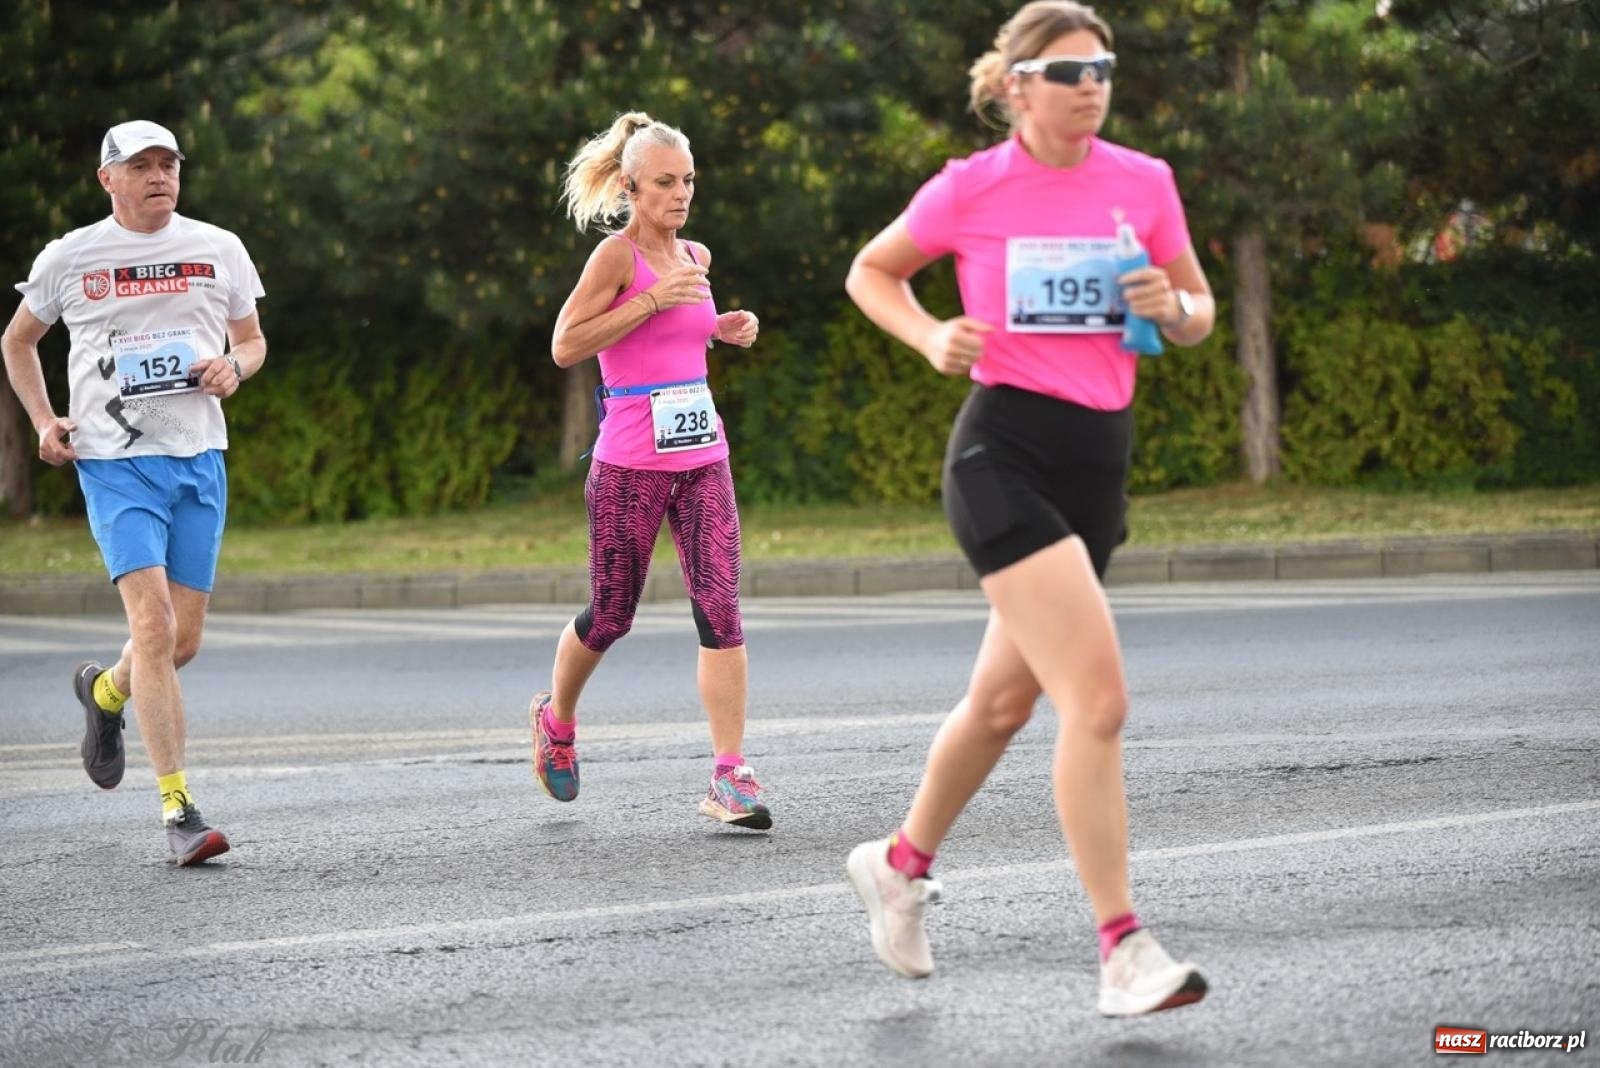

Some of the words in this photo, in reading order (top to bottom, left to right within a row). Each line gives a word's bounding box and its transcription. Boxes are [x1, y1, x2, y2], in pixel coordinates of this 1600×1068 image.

[119, 268, 131, 280] X
[136, 264, 176, 279] BIEG
[181, 263, 213, 276] BEZ
[117, 278, 187, 296] GRANIC
[1042, 277, 1102, 307] 195
[134, 333, 151, 342] BIEG
[152, 331, 165, 340] BEZ
[139, 355, 182, 379] 152
[674, 410, 708, 433] 238
